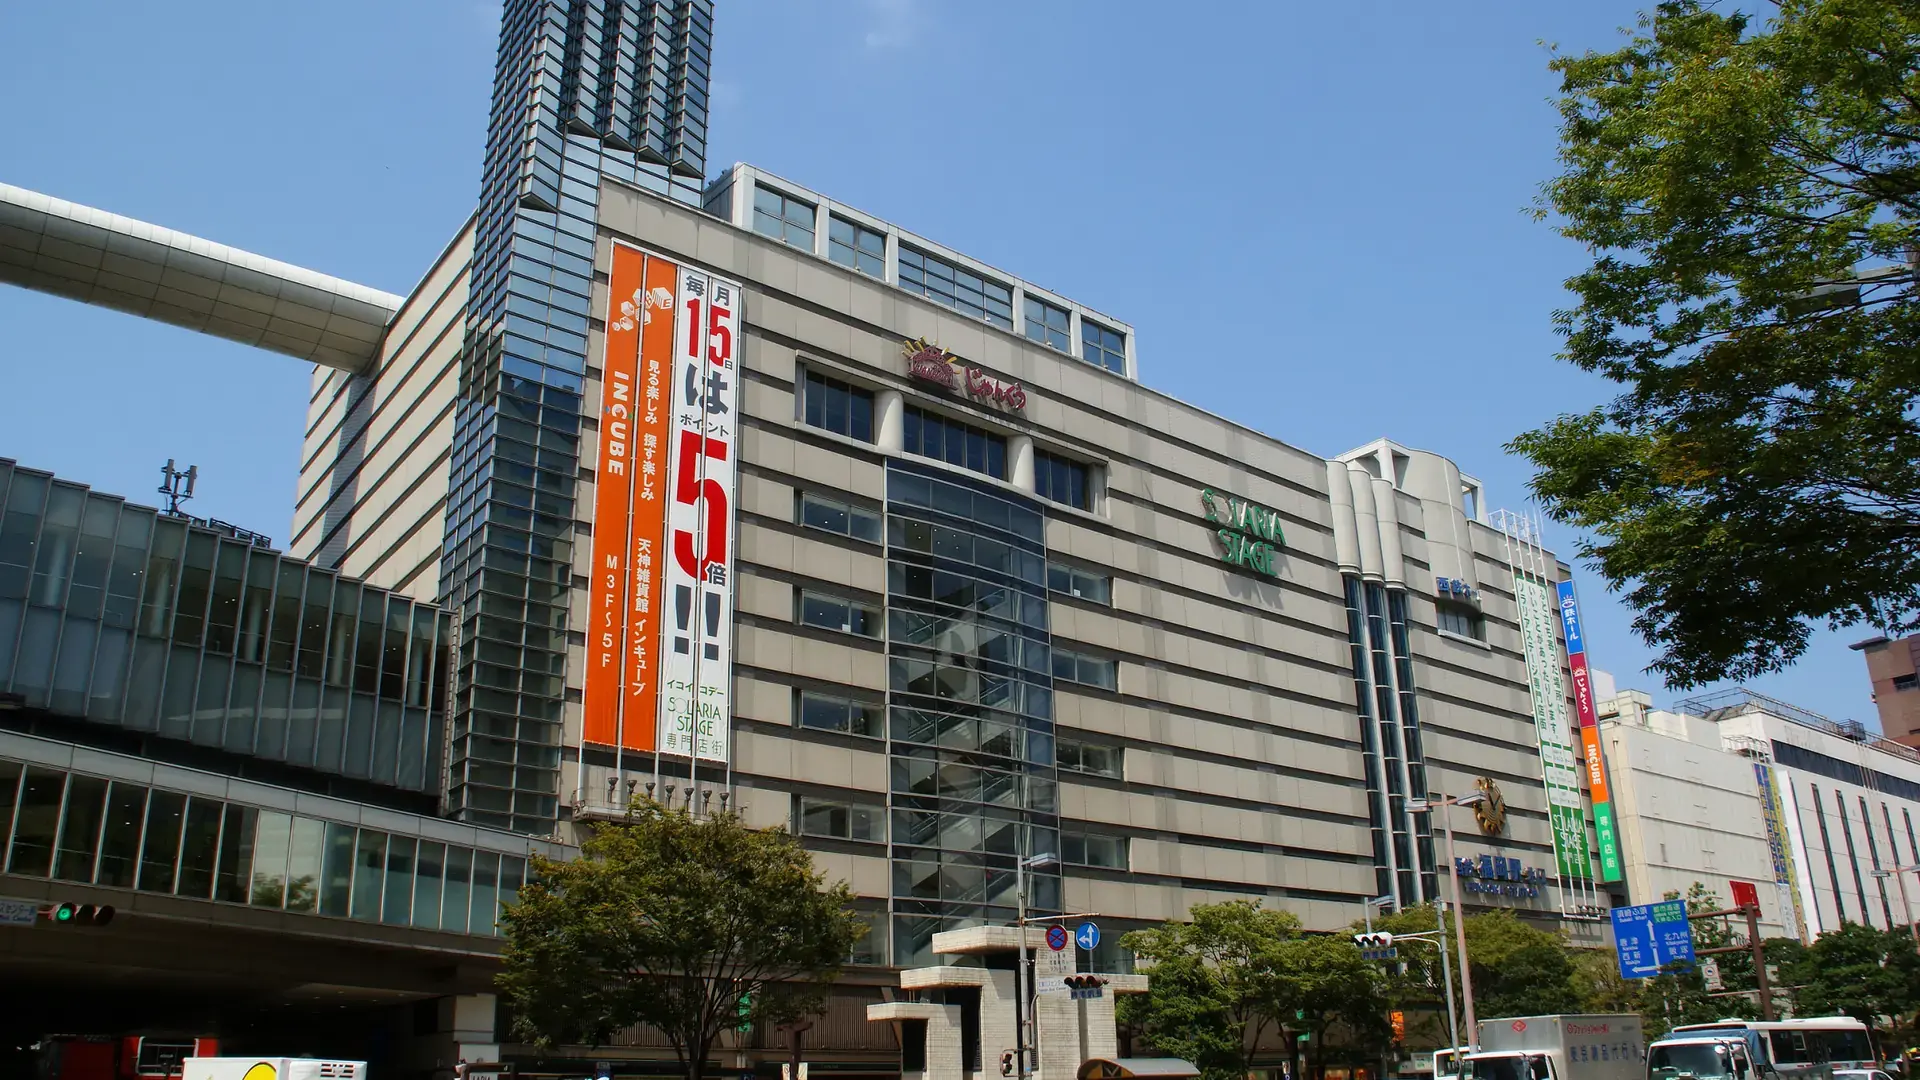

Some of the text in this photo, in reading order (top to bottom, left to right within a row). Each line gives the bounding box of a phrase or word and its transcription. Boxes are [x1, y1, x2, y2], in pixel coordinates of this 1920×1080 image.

[686, 275, 730, 306] 毎月
[685, 362, 729, 415] は
[608, 370, 630, 477] INCUBE
[641, 359, 661, 501] 見る楽しみ 探す楽しみ
[680, 413, 729, 437] ポイント
[1218, 529, 1278, 577] STAGE
[632, 538, 652, 697] 天神雑貨館 インキューブ
[668, 696, 722, 721] SOLARIA
[677, 715, 714, 737] STAGE
[666, 732, 722, 756] 専門店街
[1587, 743, 1602, 786] INCUBE
